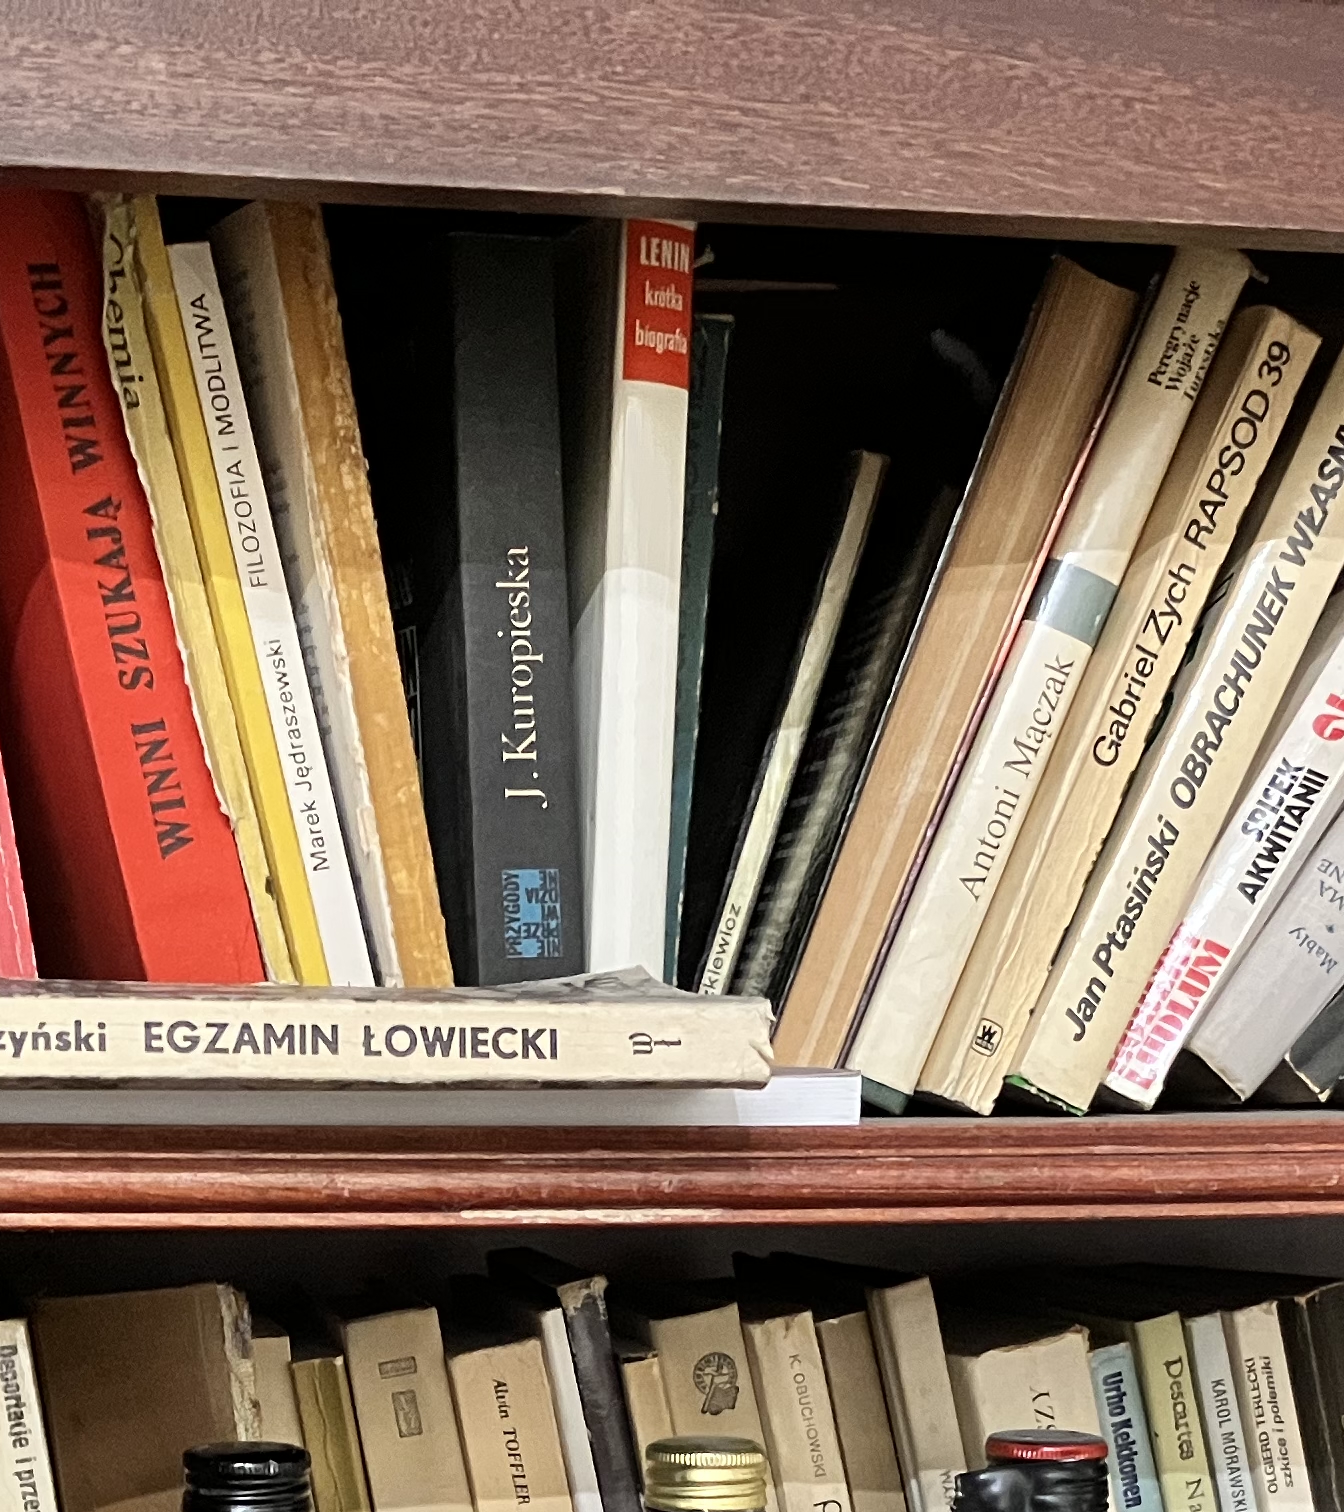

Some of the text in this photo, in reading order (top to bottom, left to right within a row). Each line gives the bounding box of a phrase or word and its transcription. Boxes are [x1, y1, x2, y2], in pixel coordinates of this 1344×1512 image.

[639, 236, 691, 275] LENIN
[644, 279, 684, 312] krótka
[190, 292, 235, 435] MODLITWA
[634, 318, 688, 355] biografia
[1147, 279, 1201, 387] Peregrynacje
[1165, 333, 1201, 392] Wojaże
[27, 262, 195, 861] WINNI SZUKAJĄ WINNYCH
[230, 458, 269, 588] FILOZOFIA
[1093, 340, 1291, 768] Gabriel Zych RAPSOD 39
[263, 638, 314, 790] Jędraszewski
[496, 545, 549, 810] J. Kuropieska
[958, 653, 1075, 901] Antoni Mączak
[1067, 972, 1108, 1043] Jan
[1092, 812, 1181, 978] Ptasiński
[1169, 566, 1296, 811] OBRACHUNEK
[1241, 756, 1305, 844] SPISEK
[299, 799, 331, 872] Marek
[1236, 766, 1330, 906] AKWITANII
[503, 870, 523, 957] PRZYGODY
[1287, 924, 1341, 975] Mably
[143, 1020, 339, 1056] EGZAMIN
[361, 1023, 560, 1061] ŁOWIECKI
[1125, 938, 1231, 1091] LUDLUM
[492, 1378, 510, 1419] Alvin
[501, 1426, 531, 1506] TOFFLER
[793, 1372, 827, 1478] OBUCHOWSKI
[1102, 1370, 1127, 1418] Urho
[1163, 1355, 1195, 1461] Descartes
[1210, 1378, 1232, 1428] KAROL
[1244, 1356, 1279, 1494] OLGIERD TERLECKI
[1258, 1355, 1294, 1489] szkice polemiki
[1110, 1420, 1142, 1511] Kekkonen
